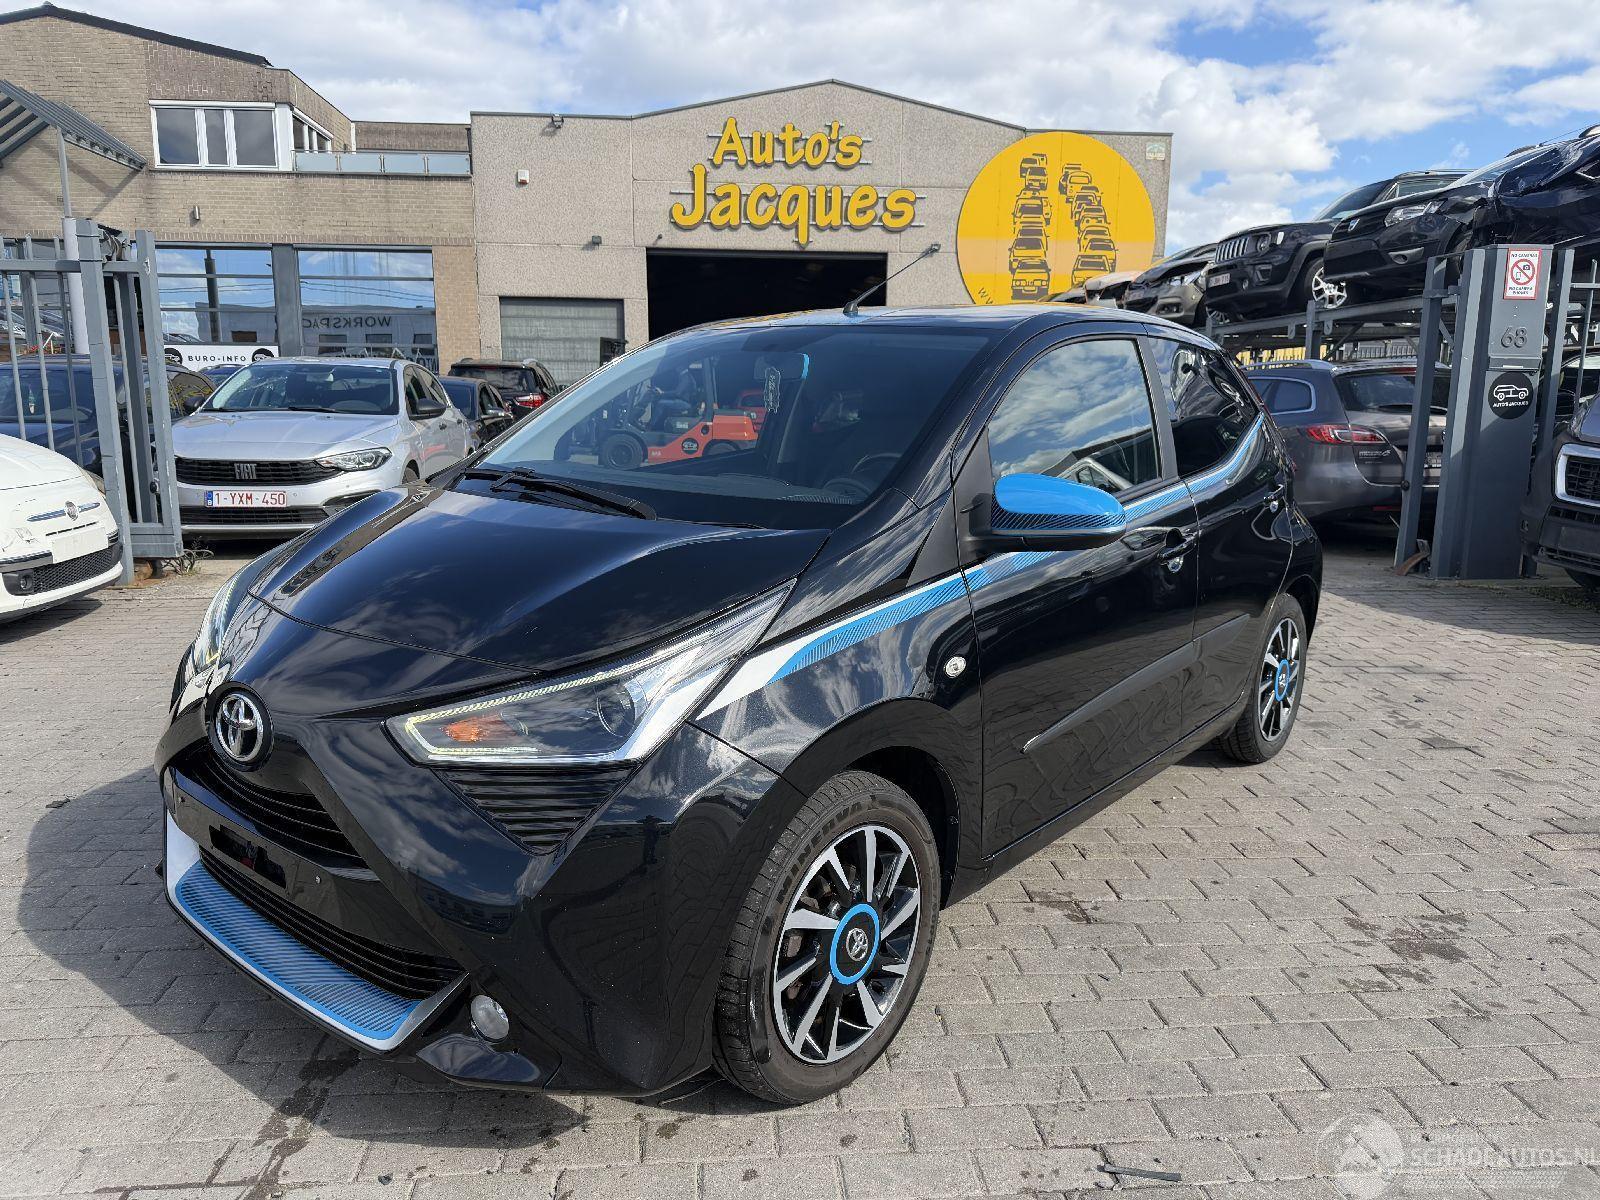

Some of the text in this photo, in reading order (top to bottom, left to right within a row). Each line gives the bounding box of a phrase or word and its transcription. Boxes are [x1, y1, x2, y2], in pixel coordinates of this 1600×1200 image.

[711, 117, 864, 168] Auto's
[670, 163, 917, 248] Jacques
[1501, 326, 1528, 348] 68
[234, 463, 257, 480] FIAT
